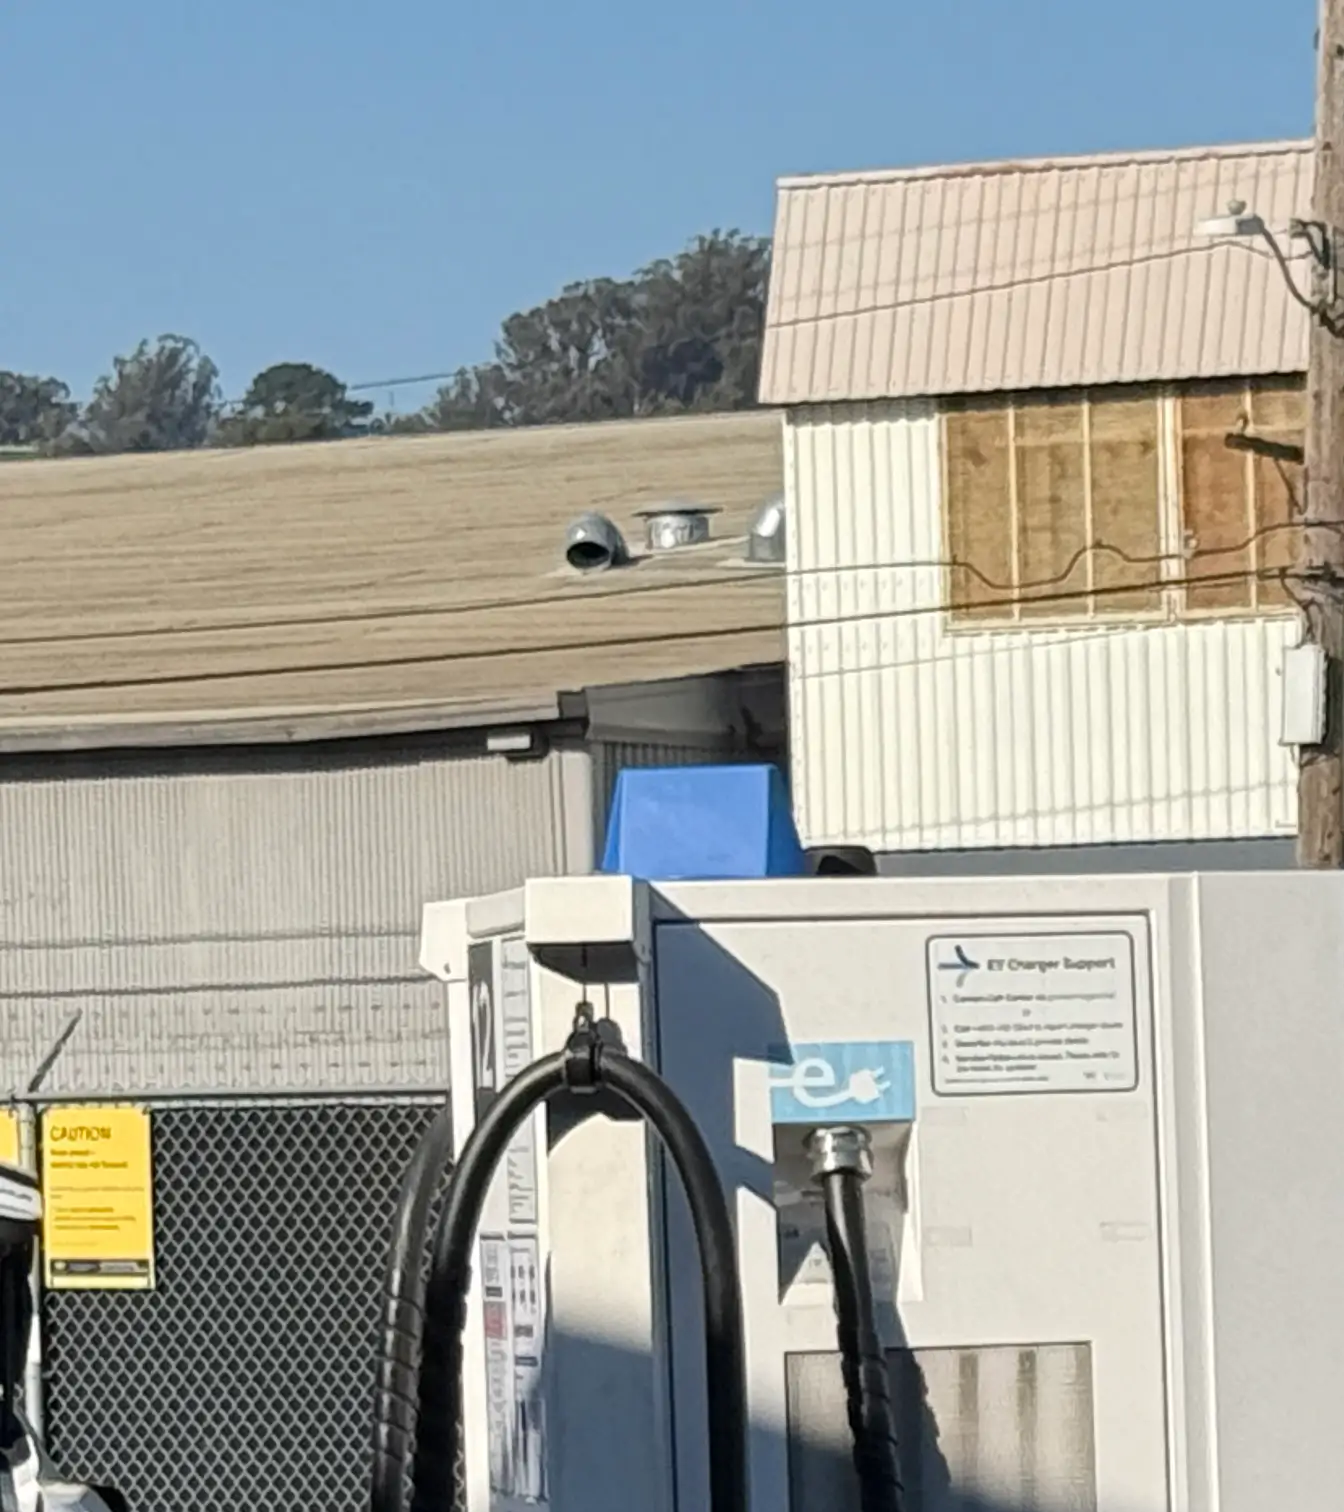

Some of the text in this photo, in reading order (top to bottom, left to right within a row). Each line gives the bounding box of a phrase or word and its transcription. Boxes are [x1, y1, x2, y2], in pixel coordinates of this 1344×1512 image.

[1007, 958, 1060, 973] Charger
[1062, 956, 1116, 971] Support
[50, 1125, 112, 1141] CAUTION
